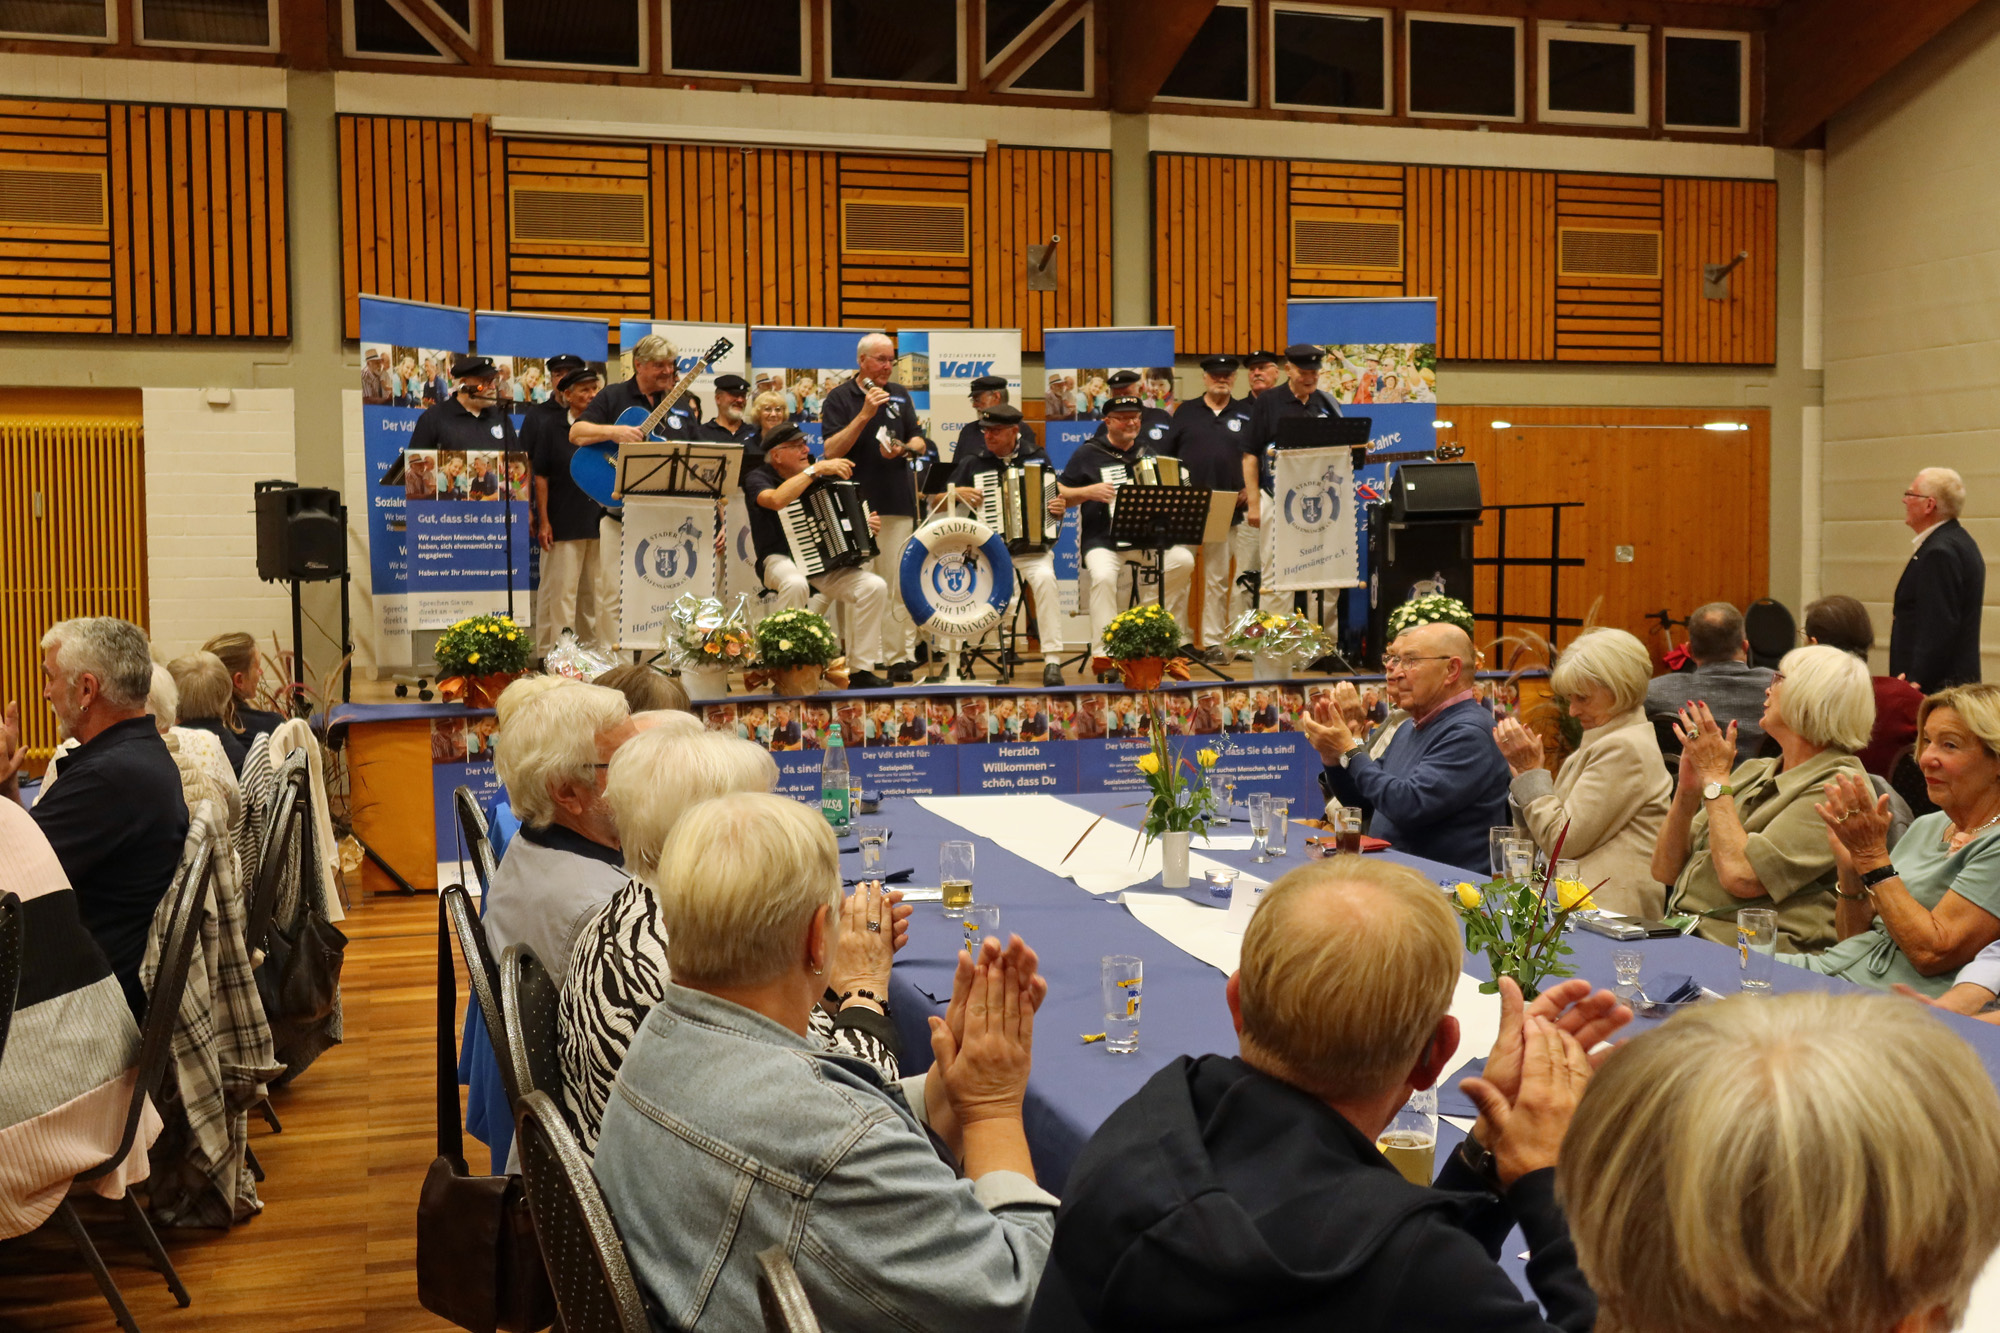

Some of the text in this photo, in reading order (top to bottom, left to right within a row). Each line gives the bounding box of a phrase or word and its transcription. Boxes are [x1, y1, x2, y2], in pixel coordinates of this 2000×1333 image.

[939, 361, 994, 378] VdK
[382, 419, 398, 432] Der
[1062, 432, 1081, 442] Der
[1296, 481, 1322, 490] STADER
[418, 514, 438, 524] Gut,
[440, 514, 462, 524] dass
[464, 514, 478, 523] Sie
[481, 514, 492, 523] da
[649, 531, 678, 541] STADER
[932, 522, 978, 539] STADER
[418, 552, 453, 560] engagieren.
[1300, 544, 1324, 558] Stader
[1284, 548, 1348, 576] Hafensänger e.V.
[935, 600, 977, 615] seit 1977
[931, 611, 997, 634] HAFENSÄNGER
[999, 746, 1040, 757] Herzlich
[1247, 746, 1260, 754] Sie
[1274, 745, 1295, 754] sind!
[782, 763, 821, 774] da sind!
[983, 762, 1046, 773] Willkommen
[982, 776, 1057, 788] schön, dass Du
